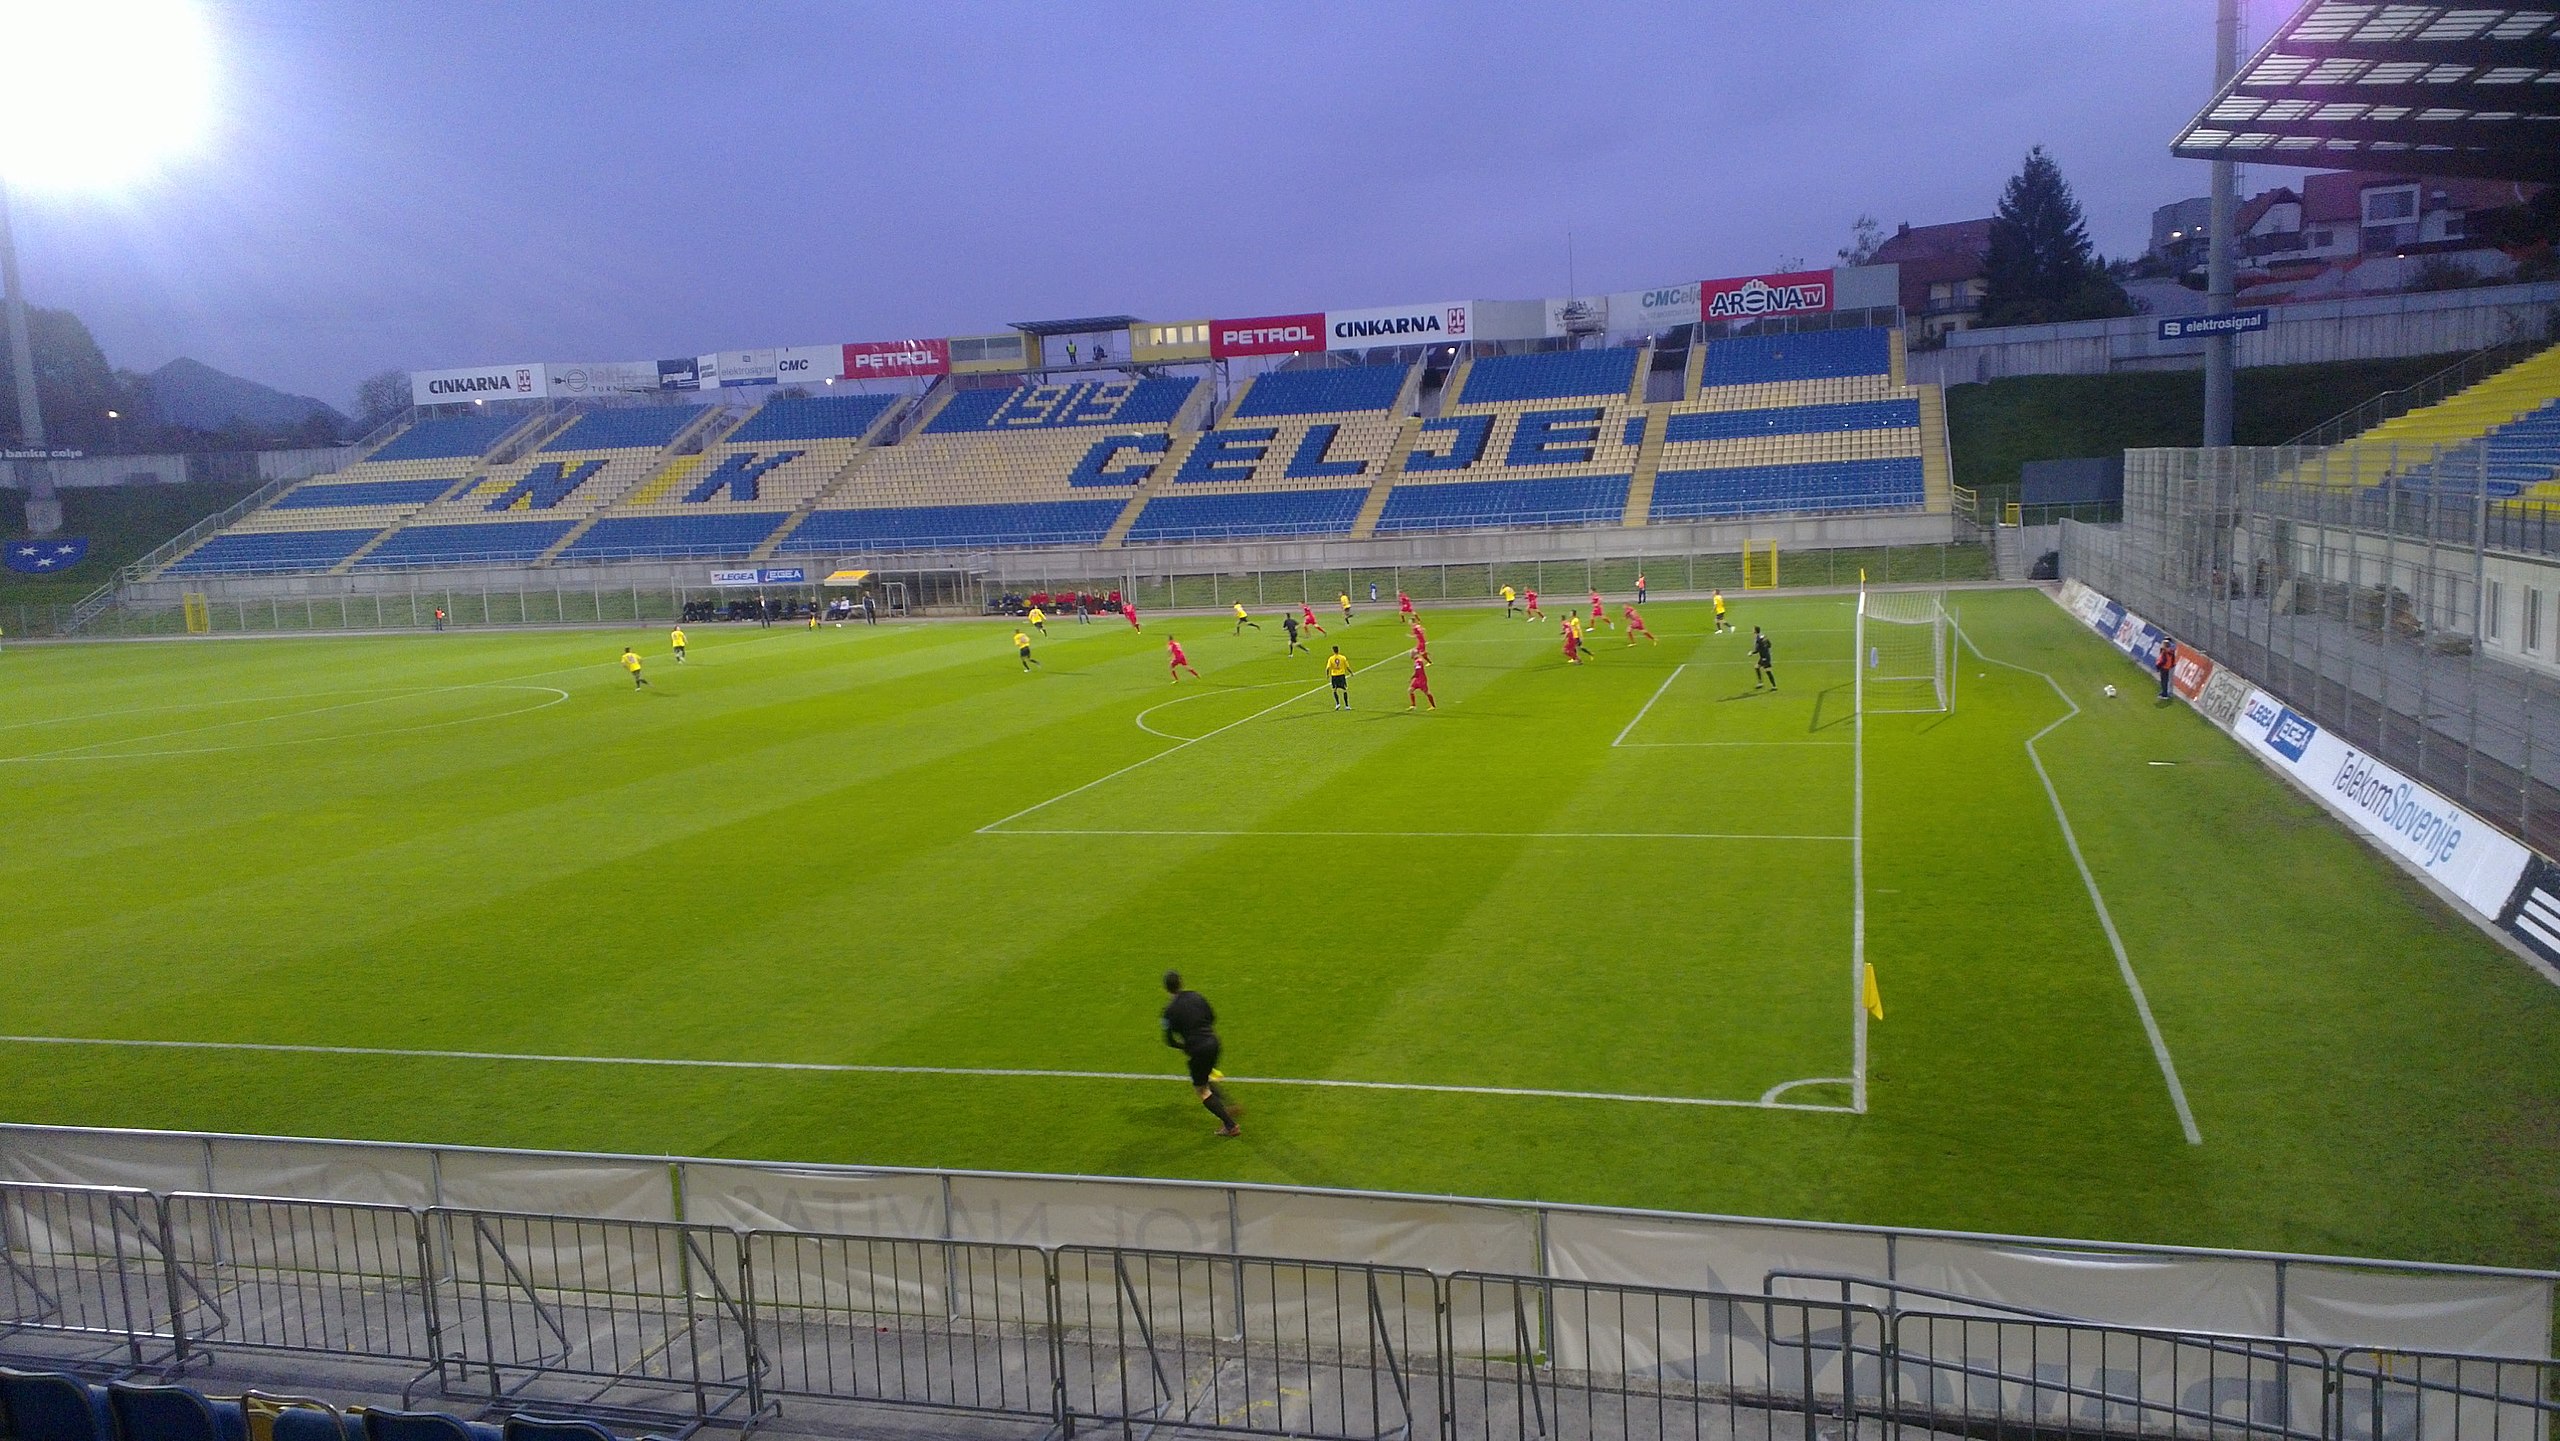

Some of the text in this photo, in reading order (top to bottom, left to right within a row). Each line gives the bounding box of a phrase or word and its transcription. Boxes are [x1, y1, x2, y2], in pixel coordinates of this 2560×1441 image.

[1804, 290, 1822, 304] TV
[1335, 315, 1441, 338] CINKARNA
[2186, 314, 2261, 333] elektrosignal
[1223, 326, 1315, 346] PETROL
[779, 358, 809, 371] CMC
[855, 350, 939, 369] PETROL
[428, 375, 512, 395] CINKARNA
[988, 379, 1138, 426] 1919
[5, 449, 47, 458] banka
[721, 572, 755, 581] LEGEA
[2250, 700, 2277, 731] LEGEA
